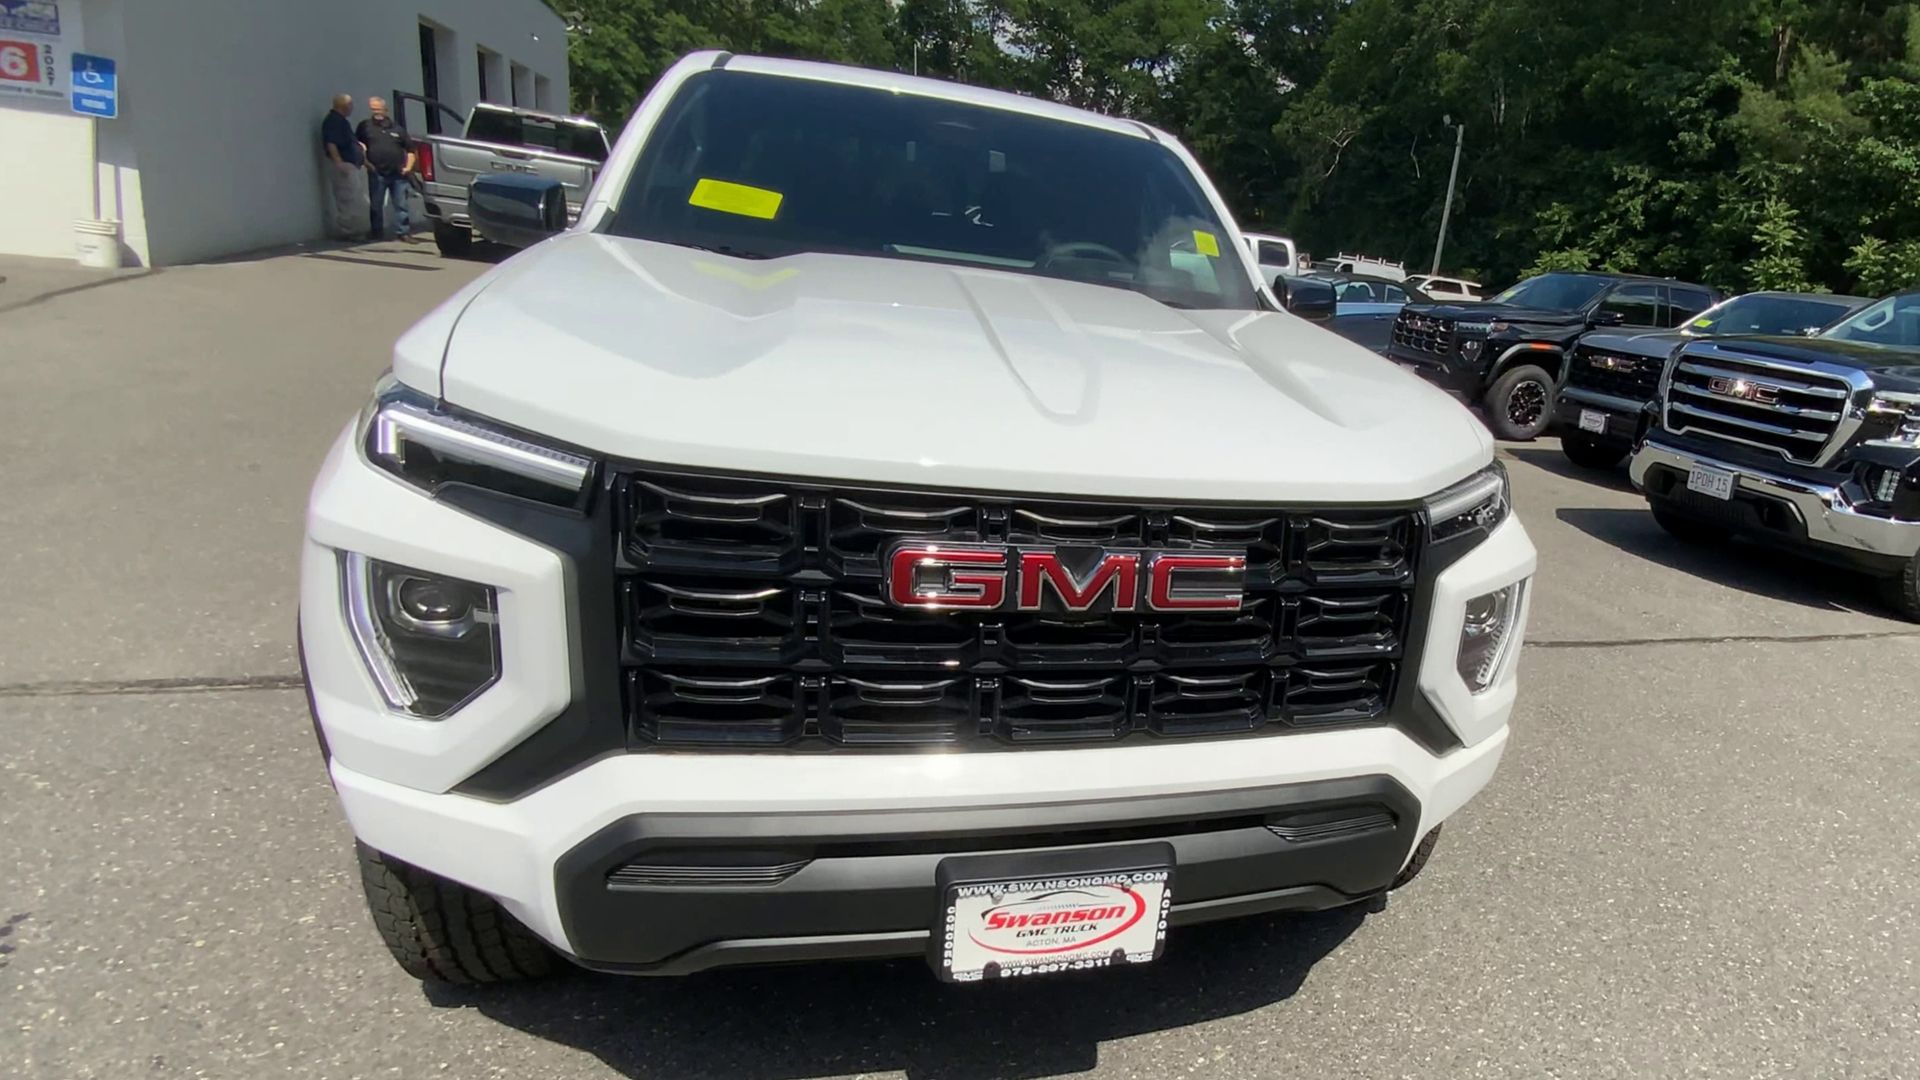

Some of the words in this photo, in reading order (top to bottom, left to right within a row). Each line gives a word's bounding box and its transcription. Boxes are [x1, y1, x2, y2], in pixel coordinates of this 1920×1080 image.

[1708, 374, 1780, 404] GMC
[1690, 470, 1713, 490] 1PDH
[1716, 478, 1728, 492] 15
[889, 545, 1247, 611] GMC
[958, 872, 1168, 897] WWW.SWANSONGMC.COM
[985, 905, 1127, 930] Swanson
[1157, 888, 1171, 940] ACTON
[943, 906, 956, 967] CONCORD
[1016, 928, 1047, 938] GMC
[1054, 923, 1098, 935] TRUCK
